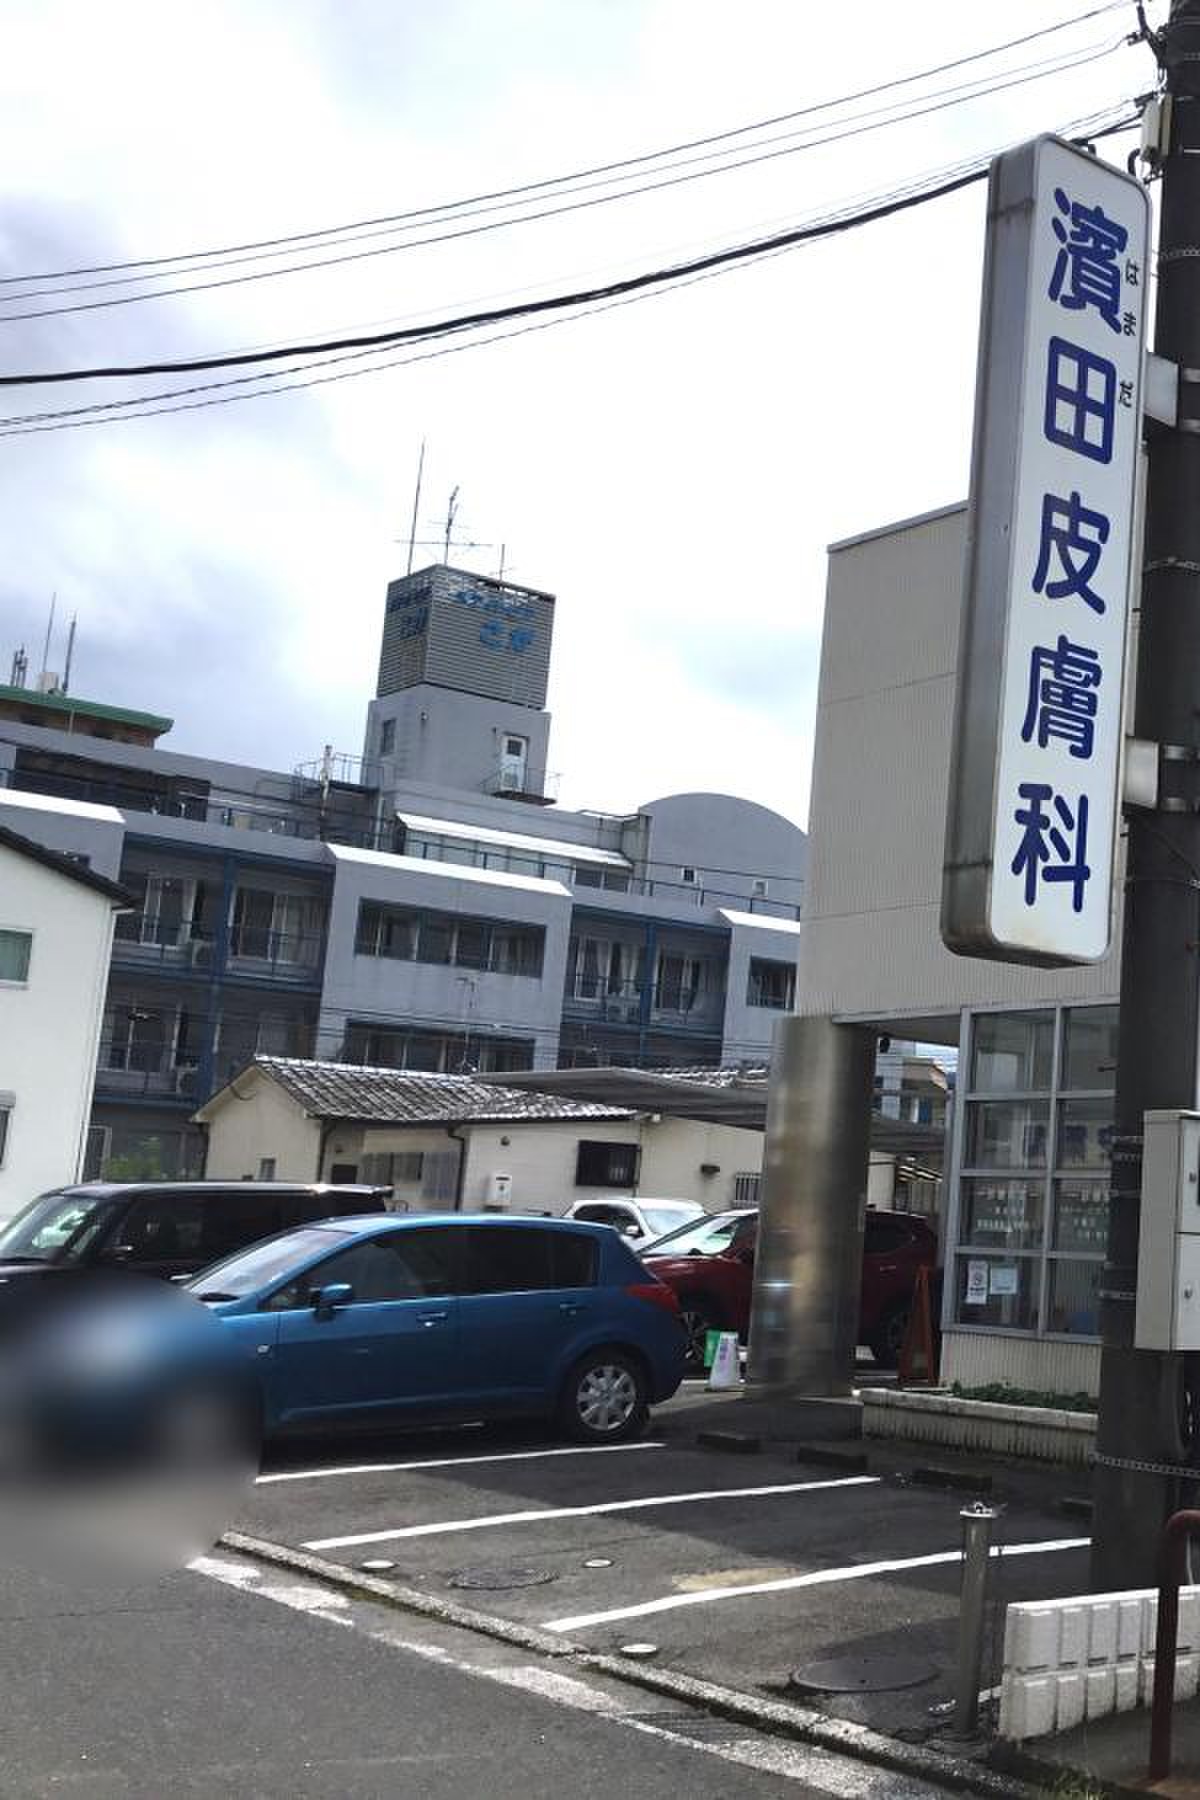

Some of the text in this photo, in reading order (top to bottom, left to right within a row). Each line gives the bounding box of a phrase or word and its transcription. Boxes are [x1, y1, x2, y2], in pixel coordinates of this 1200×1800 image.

[1011, 187, 1128, 912] 濱田皮膚科
